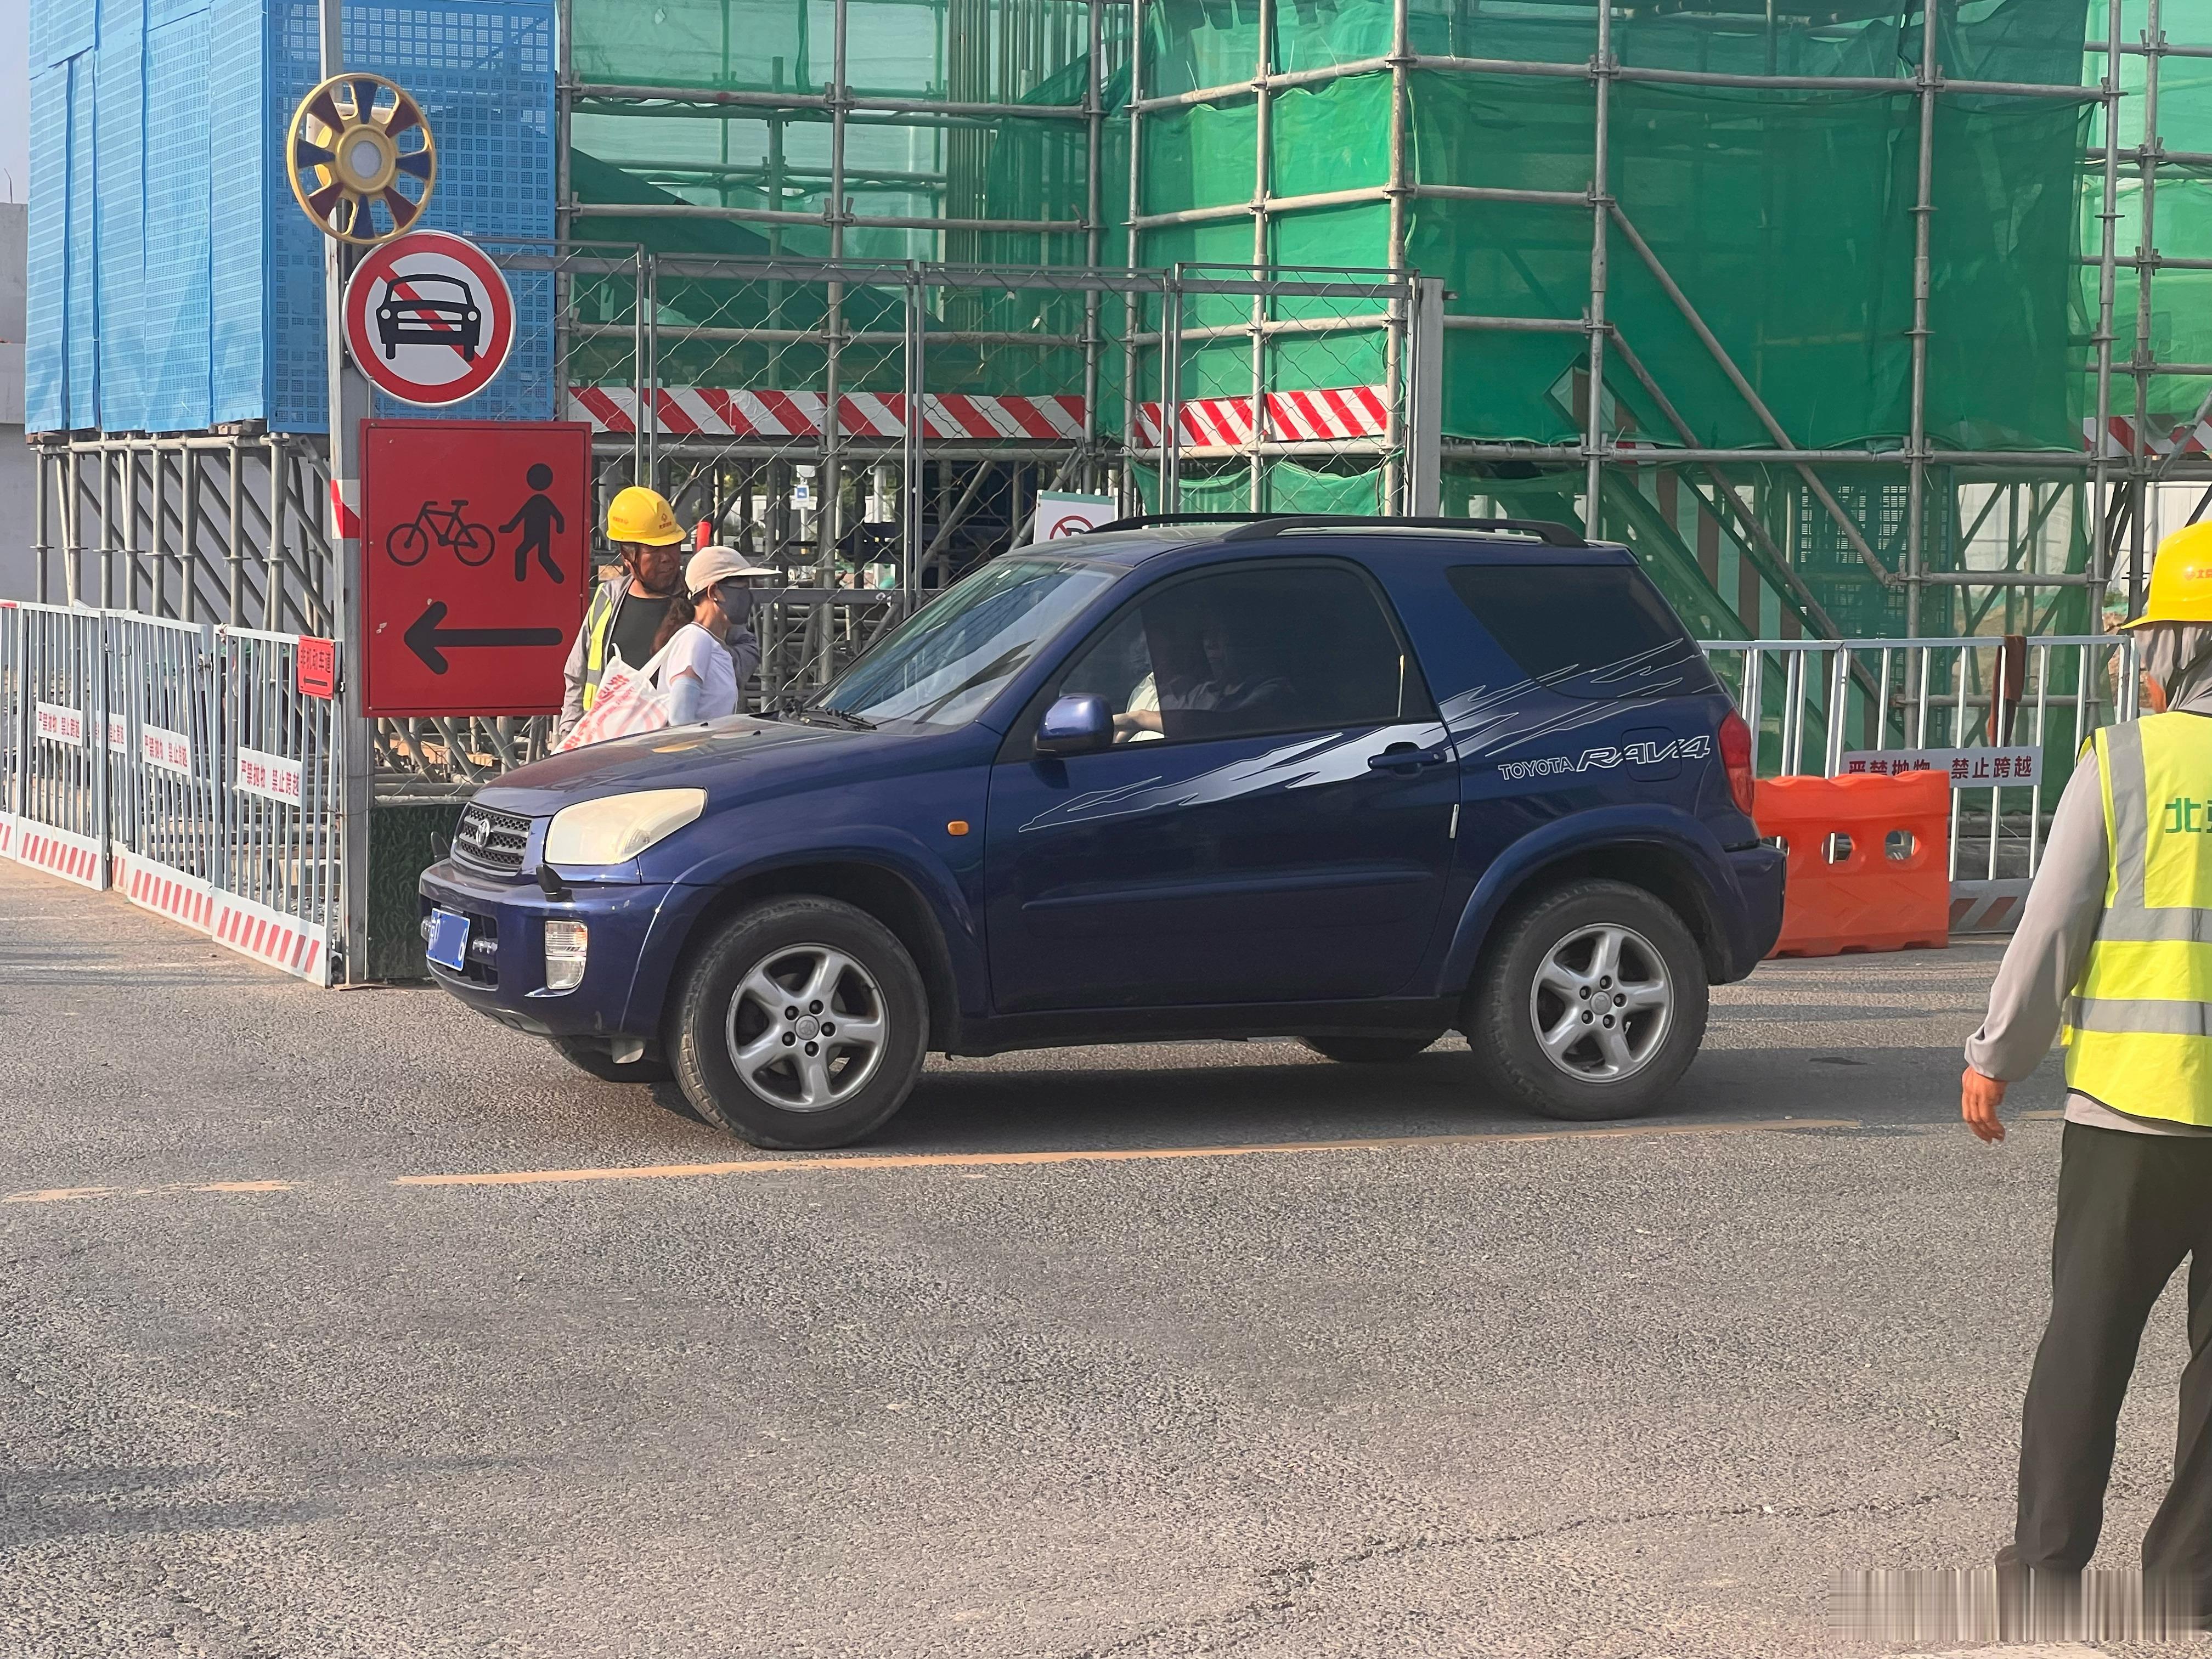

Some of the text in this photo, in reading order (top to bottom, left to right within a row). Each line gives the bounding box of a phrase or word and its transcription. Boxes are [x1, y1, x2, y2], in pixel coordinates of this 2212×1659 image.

[1498, 735, 1711, 781] TOYOTA RAV4
[1951, 755, 2032, 780] 禁止跨越
[240, 759, 299, 797] 严禁抛物 禁止跨越
[2165, 798, 2212, 833] 北
